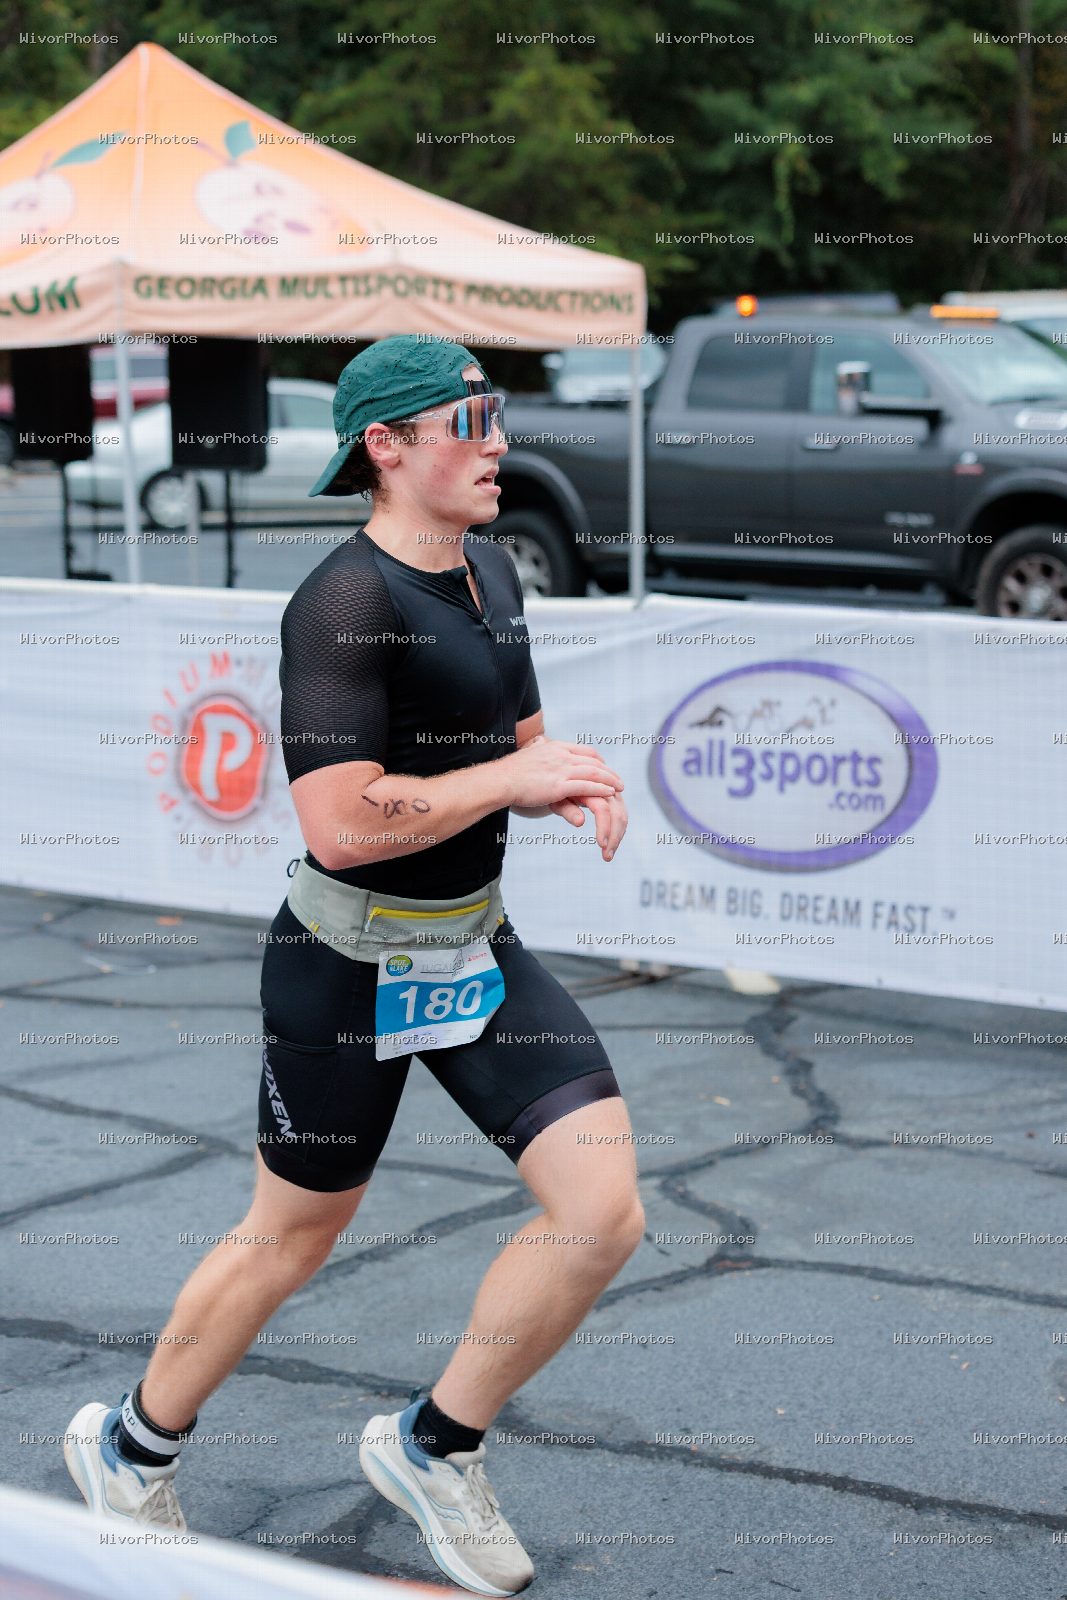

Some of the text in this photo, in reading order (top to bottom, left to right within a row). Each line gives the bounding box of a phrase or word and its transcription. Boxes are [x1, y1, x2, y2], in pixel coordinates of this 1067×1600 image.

[133, 273, 634, 315] GEORGIA MULTISPORTS PRODUCTIONS
[682, 738, 883, 799] all3sports
[827, 789, 886, 813] .com
[640, 878, 716, 913] DREAM
[726, 887, 770, 919] BIG.
[780, 890, 862, 928] DREAM
[398, 980, 484, 1024] 180
